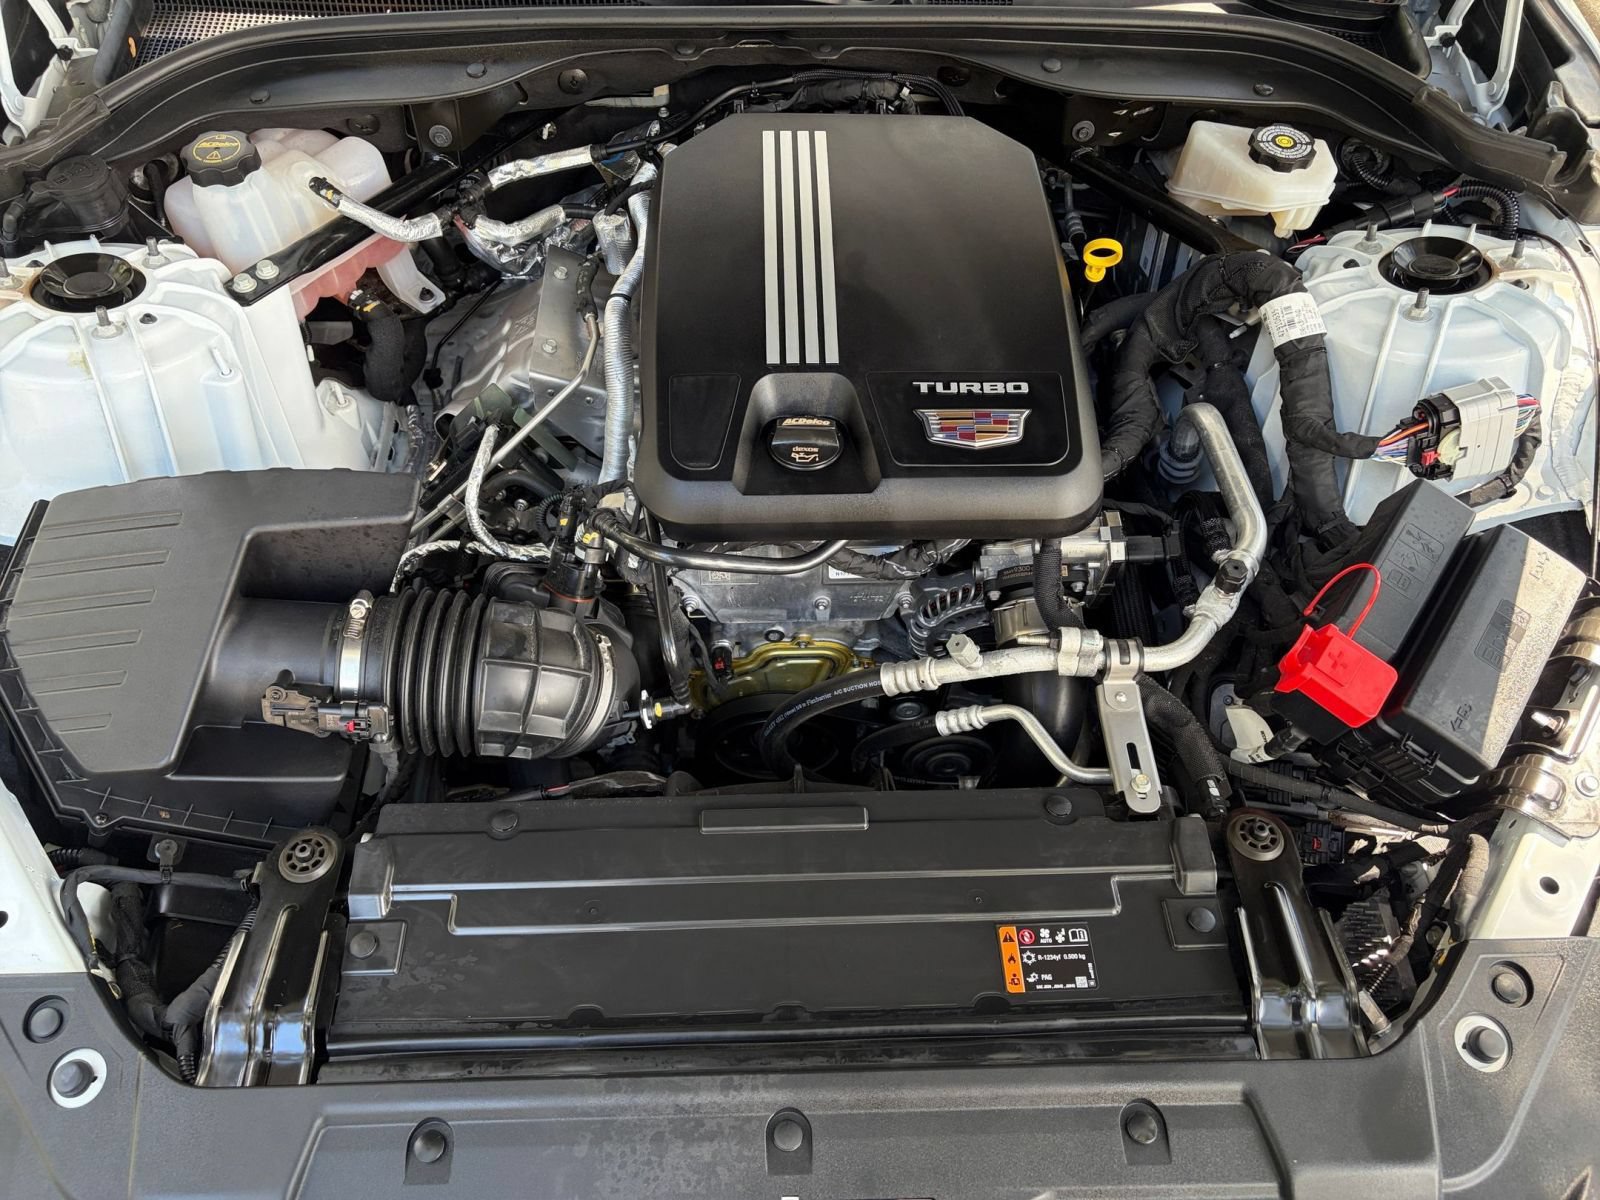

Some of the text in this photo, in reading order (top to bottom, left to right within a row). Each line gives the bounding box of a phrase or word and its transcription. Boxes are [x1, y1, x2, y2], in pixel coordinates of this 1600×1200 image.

[912, 381, 1029, 394] TURBO
[782, 418, 831, 426] ACDelco
[843, 682, 868, 694] SUCTION
